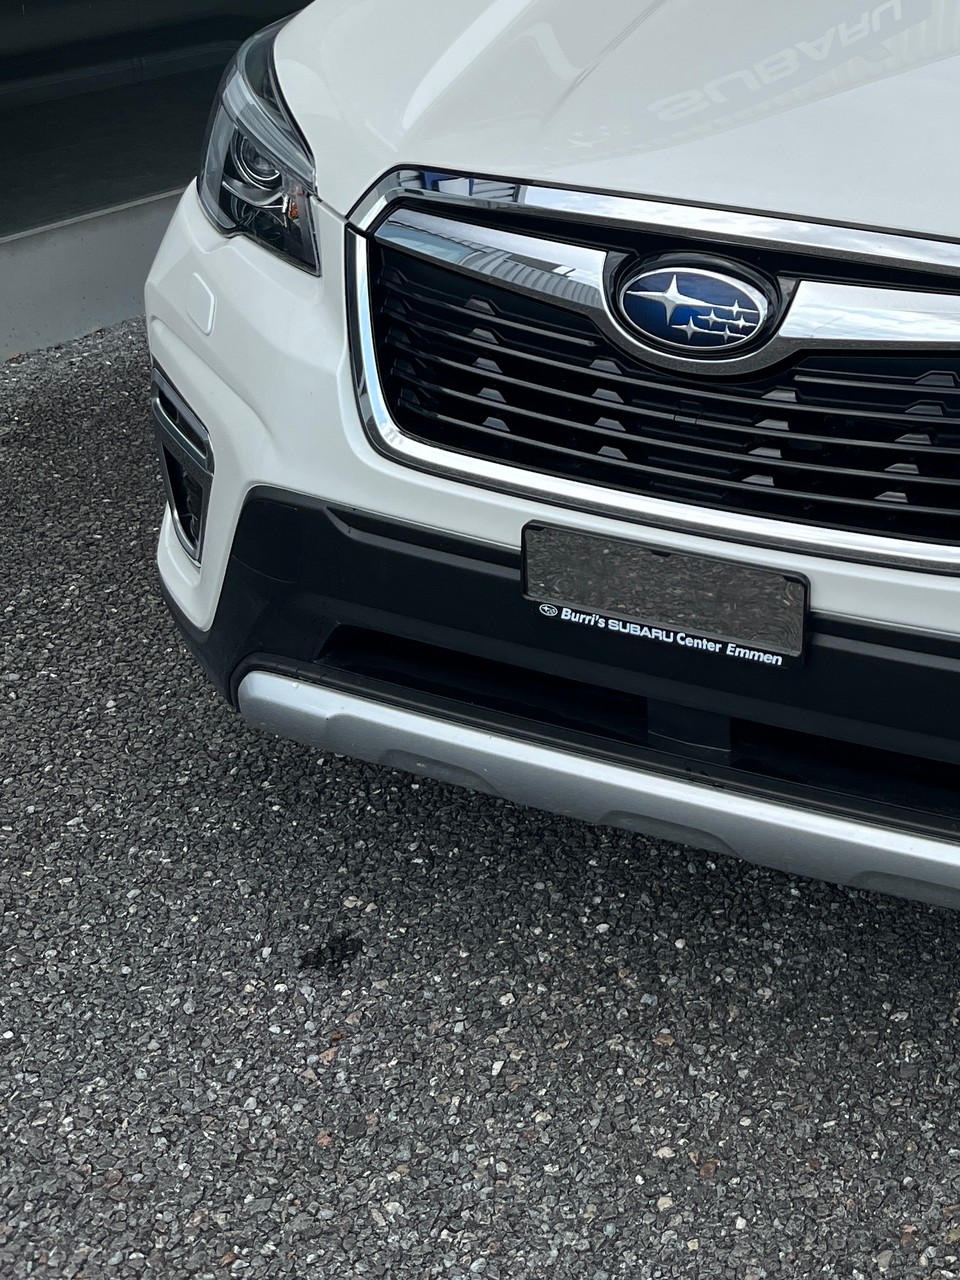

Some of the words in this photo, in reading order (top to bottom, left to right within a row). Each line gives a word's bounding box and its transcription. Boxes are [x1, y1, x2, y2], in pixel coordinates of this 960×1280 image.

[561, 607, 606, 629] Burri's
[607, 619, 674, 644] SUBARU
[676, 632, 722, 654] Center
[726, 643, 783, 666] Emmen
